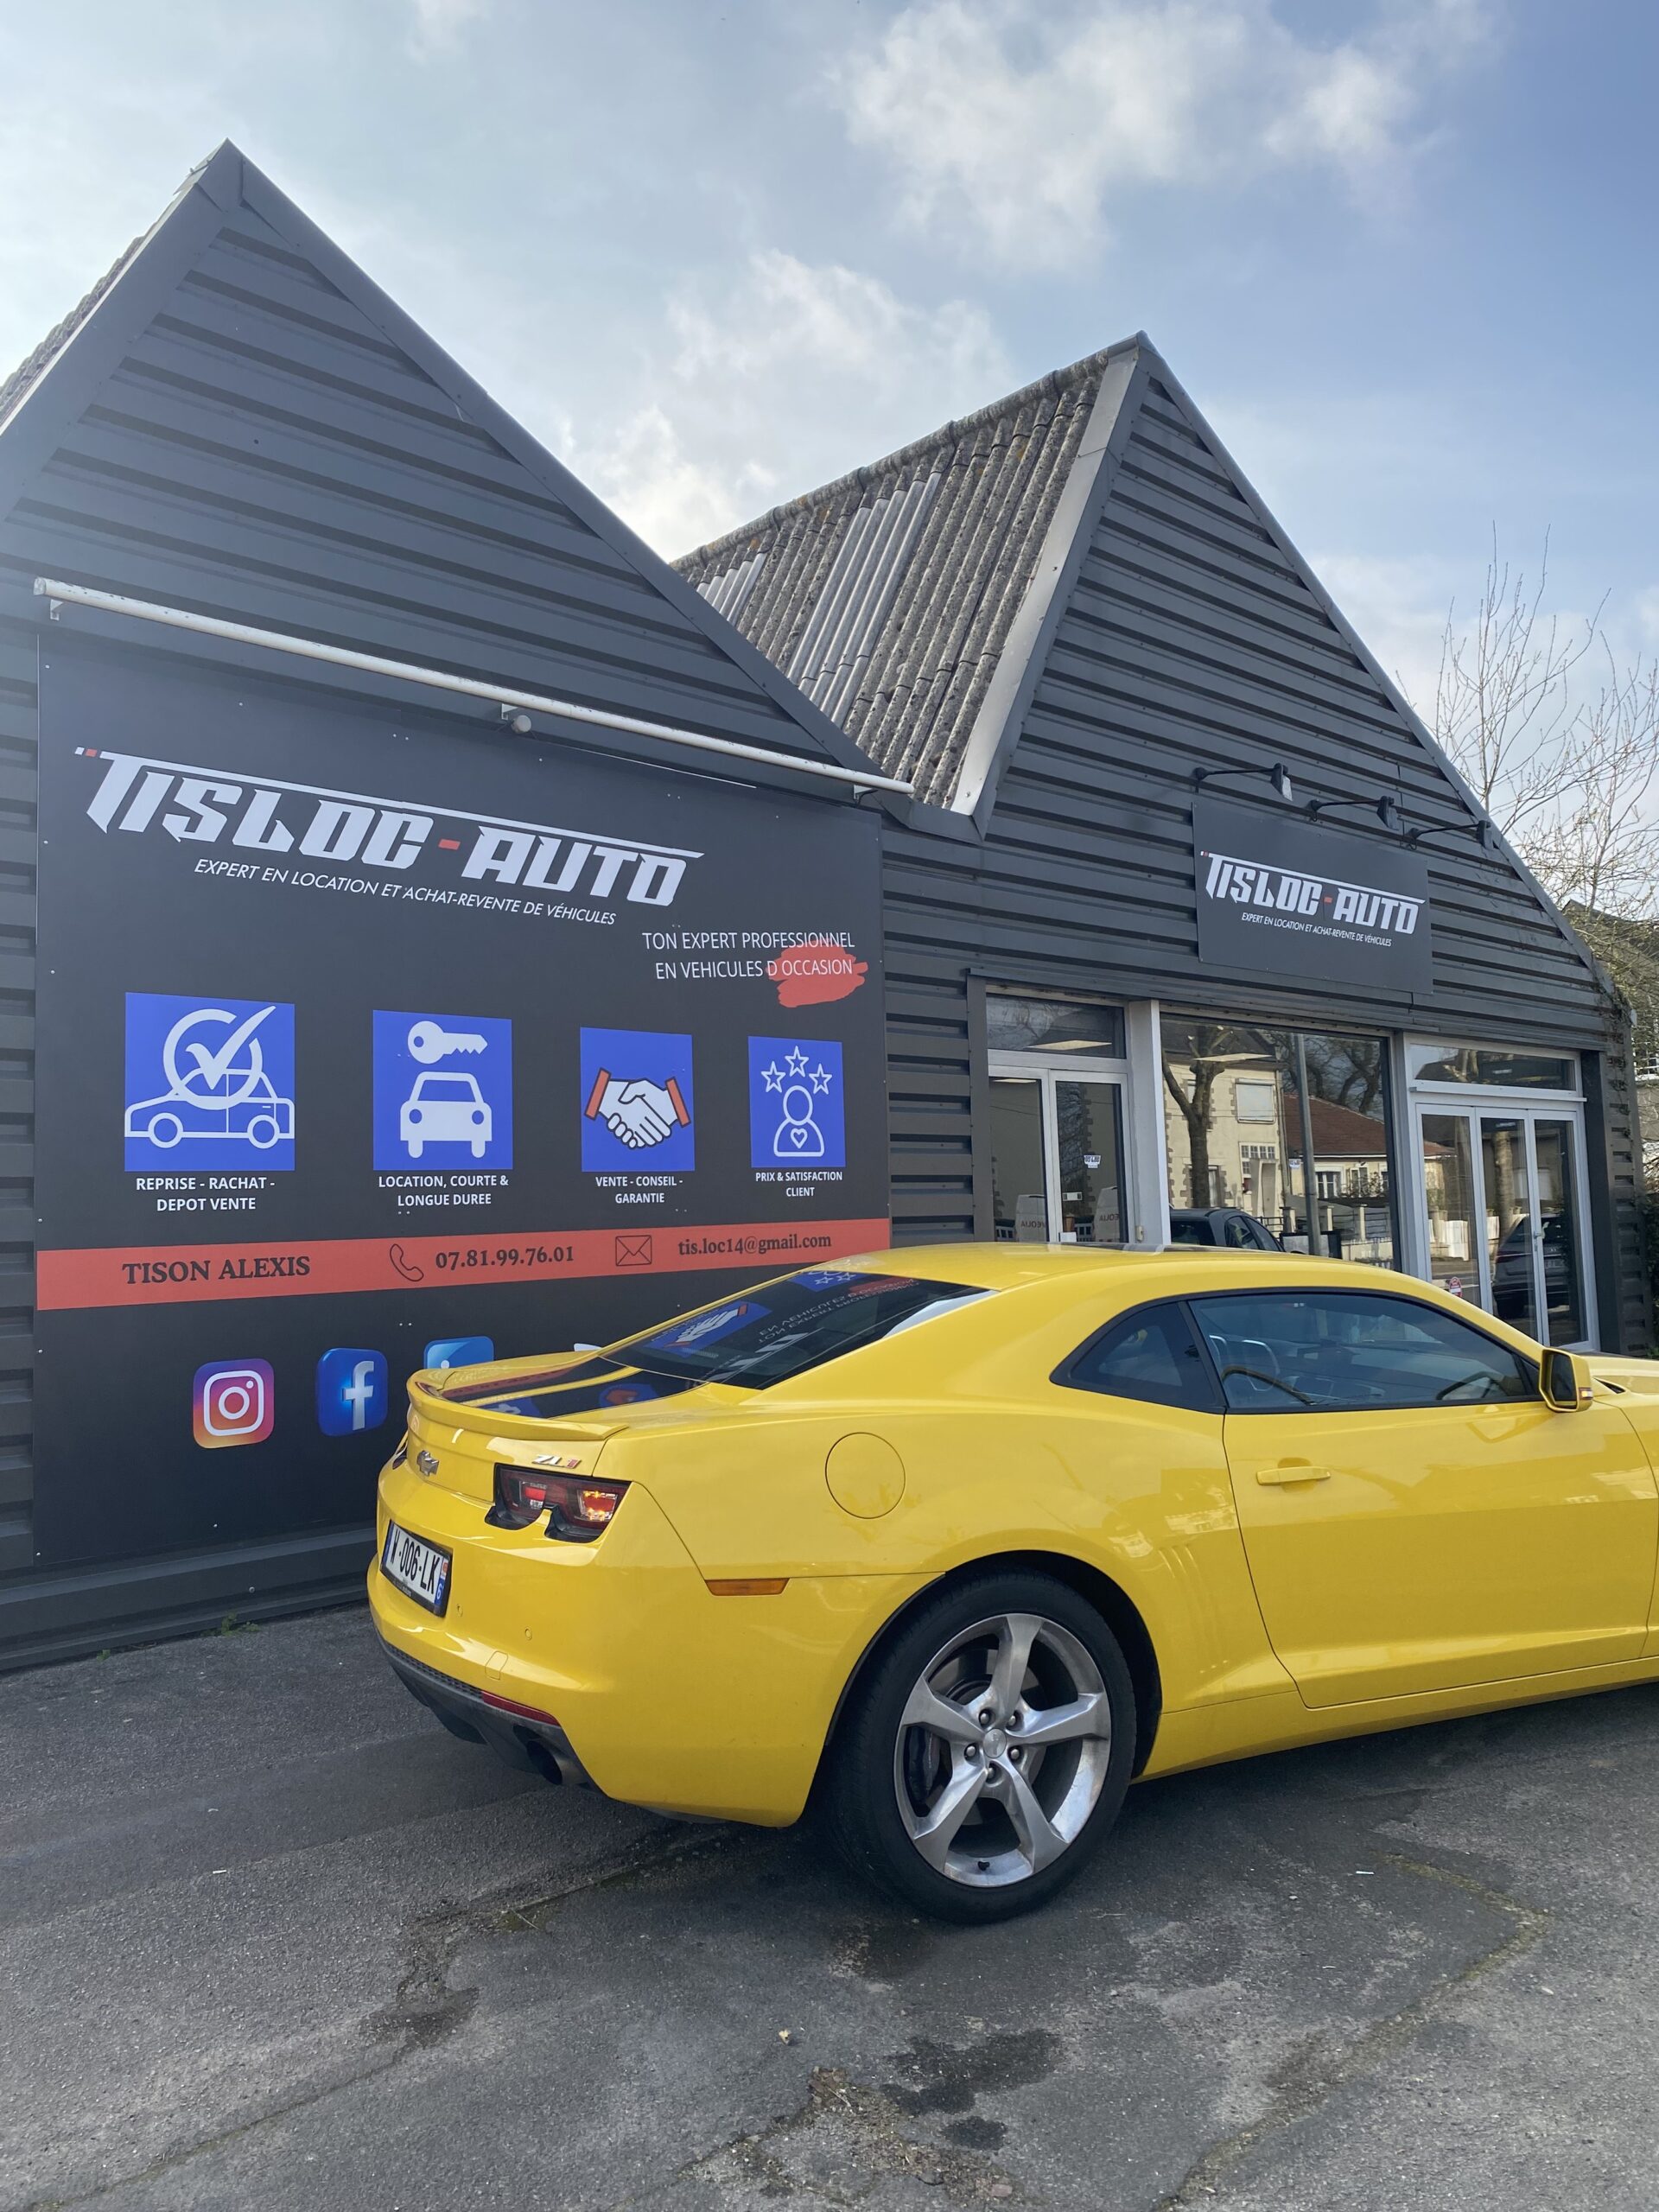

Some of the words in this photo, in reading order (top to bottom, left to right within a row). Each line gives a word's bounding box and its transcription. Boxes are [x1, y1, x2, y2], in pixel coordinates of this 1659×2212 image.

[194, 858, 261, 880] EXPERT
[261, 867, 289, 883] EN
[290, 871, 379, 895] LOCATION
[381, 883, 403, 898] ET
[402, 881, 522, 912] ACHAT-REVENTE
[523, 901, 544, 916] DE
[547, 902, 617, 925] VÉHICULES
[1242, 912, 1263, 923] EXPERT
[1274, 918, 1305, 931] LOCATION
[1313, 927, 1356, 939] ACHAT-REVENTE
[1365, 934, 1391, 946] VÉHICULES
[641, 932, 677, 950] TON
[682, 932, 738, 950] EXPERT
[741, 931, 855, 949] PROFESSIONNEL
[655, 962, 677, 980] EN
[680, 960, 764, 979] VEHICULES
[766, 960, 778, 976] D
[781, 959, 853, 976] OCCASION
[136, 1177, 196, 1191] REPRISE
[209, 1177, 267, 1190] RACHAT
[378, 1175, 447, 1189] LOCATION,
[450, 1175, 497, 1187] COURTE
[499, 1174, 509, 1186] &
[595, 1176, 628, 1187] VENTE
[635, 1176, 677, 1186] CONSEIL
[755, 1172, 775, 1182] PRIX
[777, 1172, 784, 1181] &
[785, 1171, 842, 1181] SATISFACTION
[615, 1192, 664, 1204] GARANTIE
[785, 1186, 815, 1197] CLIENT
[156, 1198, 207, 1211] DEPOT
[209, 1197, 256, 1211] VENTE
[397, 1194, 450, 1206] LONGUE
[453, 1193, 492, 1205] DUREE
[677, 1233, 832, 1255] tis.loc14@gmail.com
[435, 1246, 574, 1271] 07.81.99.76.01
[121, 1260, 211, 1285] TISON
[218, 1255, 310, 1280] ALEXIS
